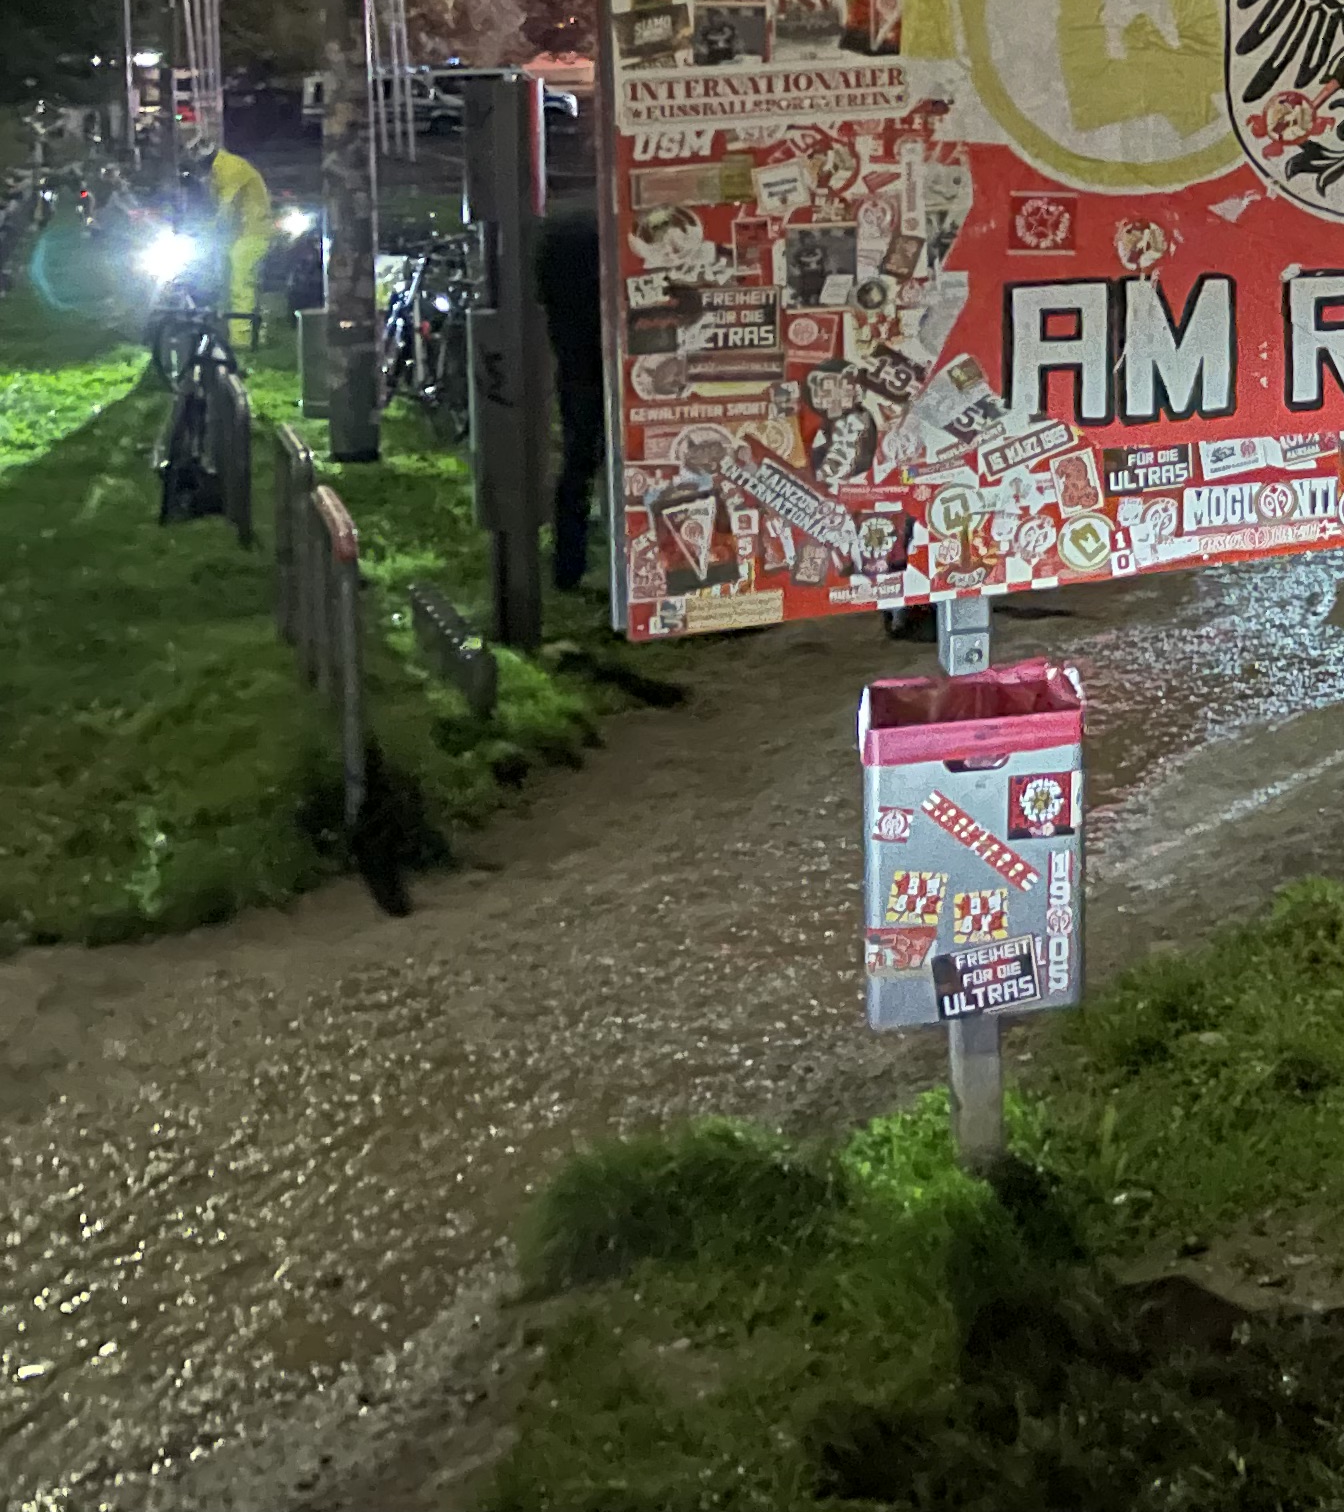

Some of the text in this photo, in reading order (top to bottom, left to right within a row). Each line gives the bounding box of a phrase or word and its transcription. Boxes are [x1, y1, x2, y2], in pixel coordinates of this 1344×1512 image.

[629, 66, 905, 102] INTERNATIONALER
[645, 91, 891, 121] FUSSBALLSPORTVEREIN
[702, 290, 777, 307] FREIHEIT
[1004, 276, 1237, 423] AM
[1127, 448, 1179, 467] FÜR DIE
[1109, 462, 1189, 492] ULTRAS
[954, 940, 1030, 970] FREIHEIT
[962, 961, 1022, 988] FÜR DIE
[943, 975, 1035, 1017] ULTRAS
